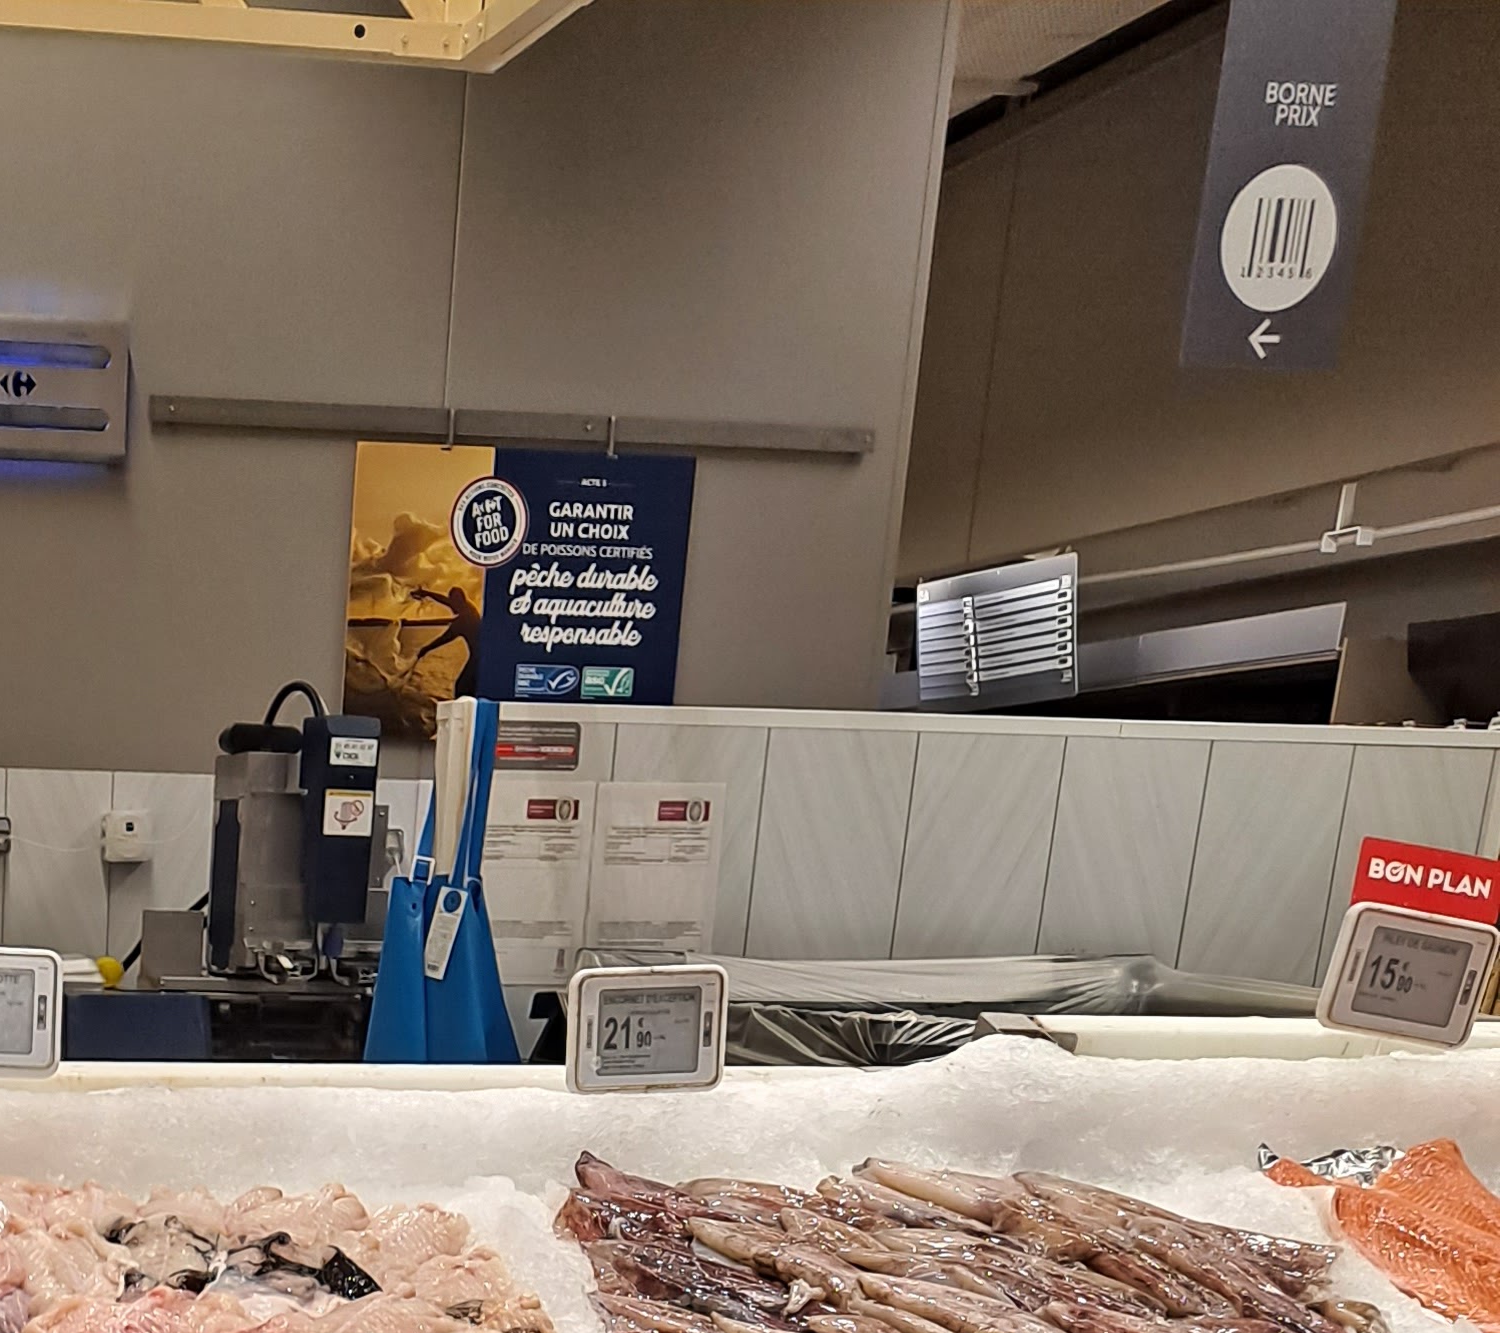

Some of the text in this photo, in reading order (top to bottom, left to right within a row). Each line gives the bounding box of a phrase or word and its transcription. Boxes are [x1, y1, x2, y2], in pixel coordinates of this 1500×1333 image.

[1265, 82, 1337, 127] BORNE PRIX
[476, 512, 502, 532] FOR
[549, 502, 633, 520] GARANTIR
[474, 526, 509, 549] FOOD
[550, 522, 629, 540] UN CHOIX
[522, 543, 538, 555] DE
[540, 544, 596, 557] POISSONS
[509, 562, 658, 595] pêche durable
[509, 589, 656, 624] et aquaculture
[520, 623, 642, 653] responsable
[1368, 857, 1492, 899] BON PLAN
